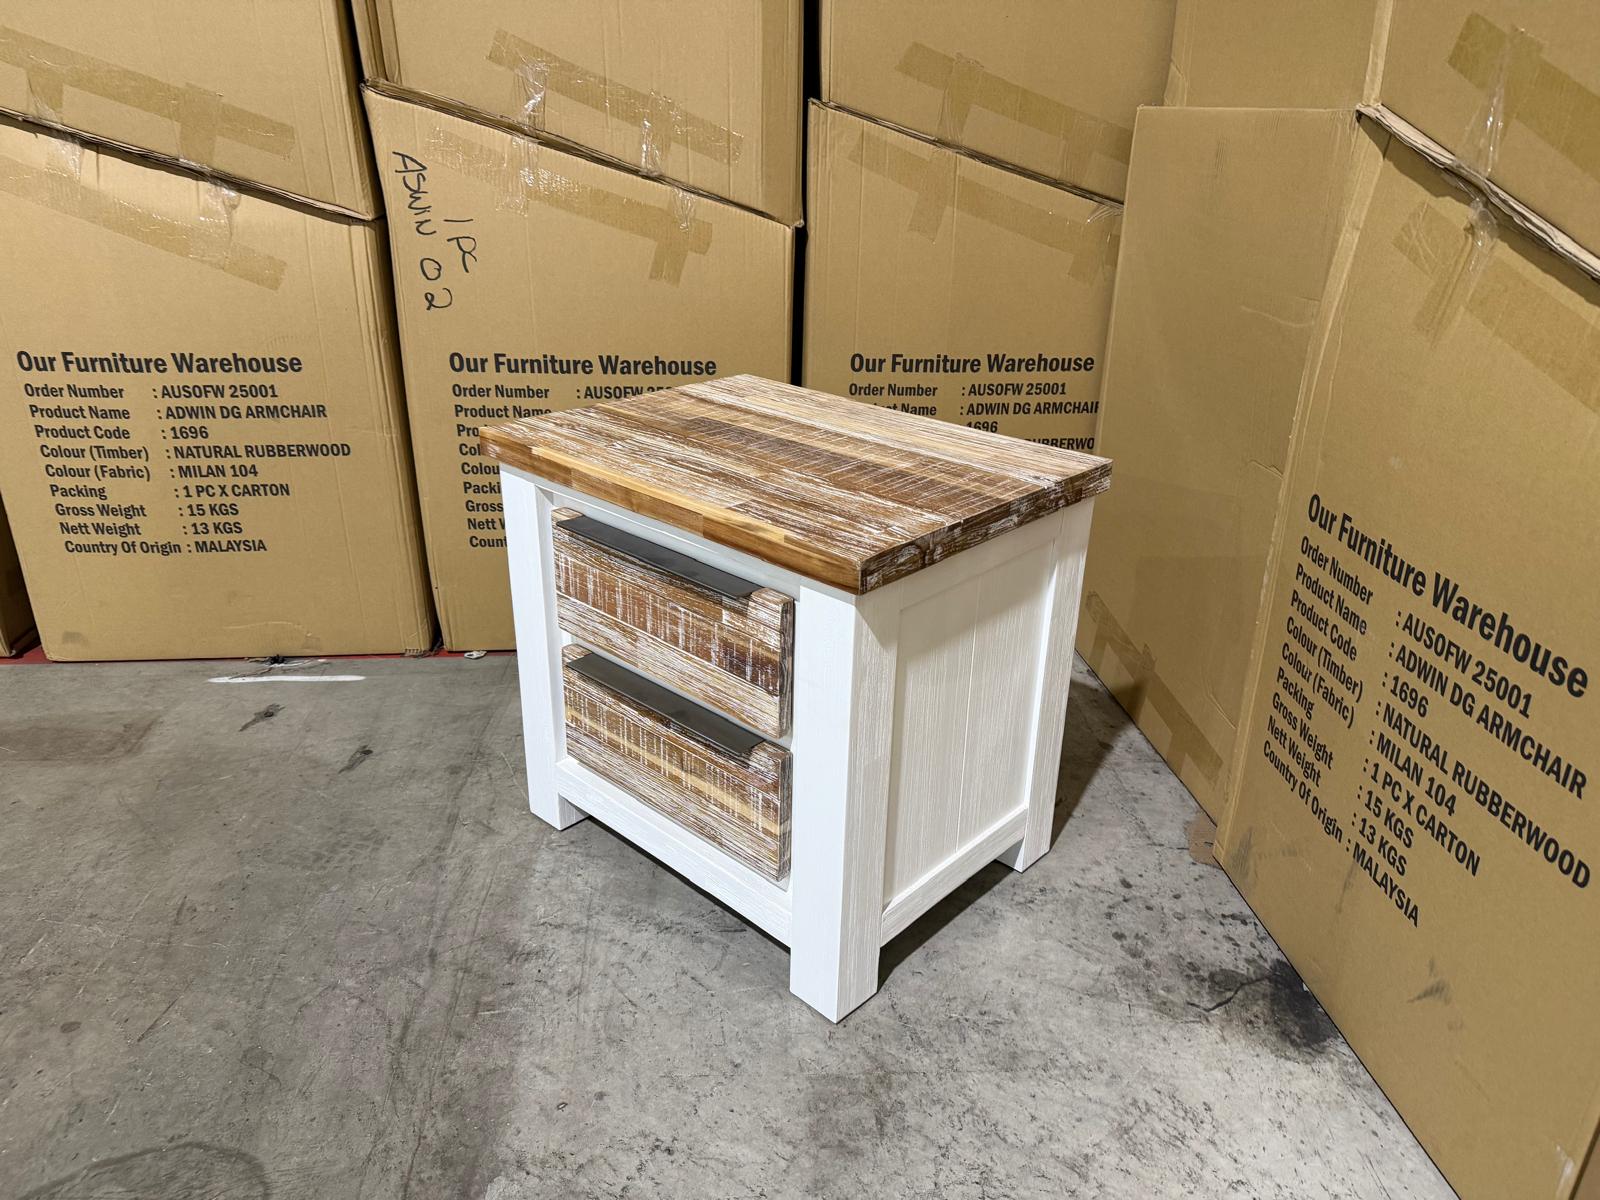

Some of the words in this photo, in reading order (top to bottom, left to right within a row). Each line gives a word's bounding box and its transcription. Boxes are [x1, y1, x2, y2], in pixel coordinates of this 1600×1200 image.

[17, 351, 56, 372] Our
[61, 352, 167, 373] Furniture
[170, 353, 302, 373] Warehouse
[449, 352, 488, 373] Our
[494, 353, 594, 375] Furniture
[598, 355, 717, 375] Warehouse
[850, 353, 886, 373] Our
[891, 354, 982, 373] Furniture
[987, 354, 1095, 372] Warehouse
[24, 383, 64, 397] Order
[66, 384, 124, 398] Number
[161, 385, 225, 399] AUSOFW
[229, 384, 278, 398] 25001
[452, 383, 491, 397] Order
[494, 384, 550, 398] Number
[584, 386, 644, 399] AUSOFW
[849, 383, 885, 396] Order
[887, 384, 938, 397] Number
[968, 383, 1024, 396] AUSOFW
[1025, 382, 1066, 395] 25001
[29, 404, 87, 419] Product
[88, 406, 130, 419] Name
[166, 406, 216, 419] ADWIN
[219, 405, 242, 419] DG
[246, 404, 327, 419] ARMCHAIR
[454, 404, 509, 418] Product
[901, 403, 937, 416] Name
[966, 402, 1010, 416] ADWIN
[1013, 402, 1031, 415] DG
[34, 425, 92, 439] Product
[93, 425, 130, 439] Code
[170, 426, 209, 439] 1696
[40, 444, 86, 458] Colour
[89, 445, 149, 462] (Timber)
[173, 445, 242, 459] NATURAL
[244, 443, 351, 458] RUBBERWOOD
[45, 464, 90, 478] Colour
[94, 465, 150, 482] (Fabric)
[178, 465, 226, 478] MILAN
[230, 464, 258, 477] 104
[461, 462, 500, 475] Colou
[49, 484, 107, 501] Packing
[183, 485, 193, 498] 1
[195, 485, 216, 497] PC
[218, 484, 229, 497] X
[231, 483, 290, 497] CARTON
[463, 481, 501, 494] Packi
[55, 503, 95, 516] Gross
[96, 504, 147, 520] Weight
[187, 504, 206, 516] 15
[209, 503, 239, 516] KGS
[465, 500, 504, 512] Gross
[59, 522, 91, 535] Nett
[91, 522, 142, 538] Weight
[191, 522, 209, 535] 13
[213, 521, 243, 534] KGS
[467, 518, 497, 530] Nett
[65, 540, 118, 556] Country
[121, 541, 137, 553] Of
[140, 541, 182, 556] Origin
[194, 539, 267, 553] MALAYSIA
[1308, 494, 1337, 534] Our
[1338, 513, 1426, 596] Furniture
[1432, 572, 1588, 698] Warehouse
[1301, 536, 1329, 571] Order
[1329, 557, 1373, 605] Number
[1402, 613, 1472, 674] AUSOFW
[1471, 660, 1532, 719] 25001
[1291, 589, 1329, 637] Product
[1330, 624, 1357, 661] Code
[1390, 675, 1429, 718] 1696
[1296, 563, 1334, 609] Product
[1335, 594, 1367, 635] Name
[1395, 645, 1448, 697] ADWIN
[1449, 682, 1475, 718] DG
[1476, 704, 1587, 800] ARMCHAIR
[1282, 642, 1312, 683] Colour
[1312, 672, 1354, 729] (Fabric)
[1377, 732, 1423, 787] MILAN
[1425, 777, 1456, 816] 104
[1287, 616, 1318, 657] Colour
[1318, 646, 1363, 703] (Timber)
[1383, 702, 1448, 775] NATURAL
[1452, 760, 1590, 888] RUBBERWOOD
[1272, 692, 1298, 731] Gross
[1299, 718, 1333, 770] Weight
[1365, 790, 1383, 818] 15
[1384, 808, 1414, 848] KGS
[1277, 666, 1315, 721] Packing
[1371, 763, 1379, 783] 1
[1382, 771, 1402, 802] PC
[1402, 790, 1415, 816] X
[1416, 804, 1480, 877] CARTON
[1267, 715, 1287, 749] Nett
[1288, 737, 1321, 788] Weight
[1359, 818, 1376, 845] 13
[1378, 835, 1407, 876] KGS
[1264, 740, 1298, 792] Country
[1299, 781, 1311, 805] Of
[1311, 796, 1343, 843] Origin
[1353, 841, 1418, 928] MALAYSIA
